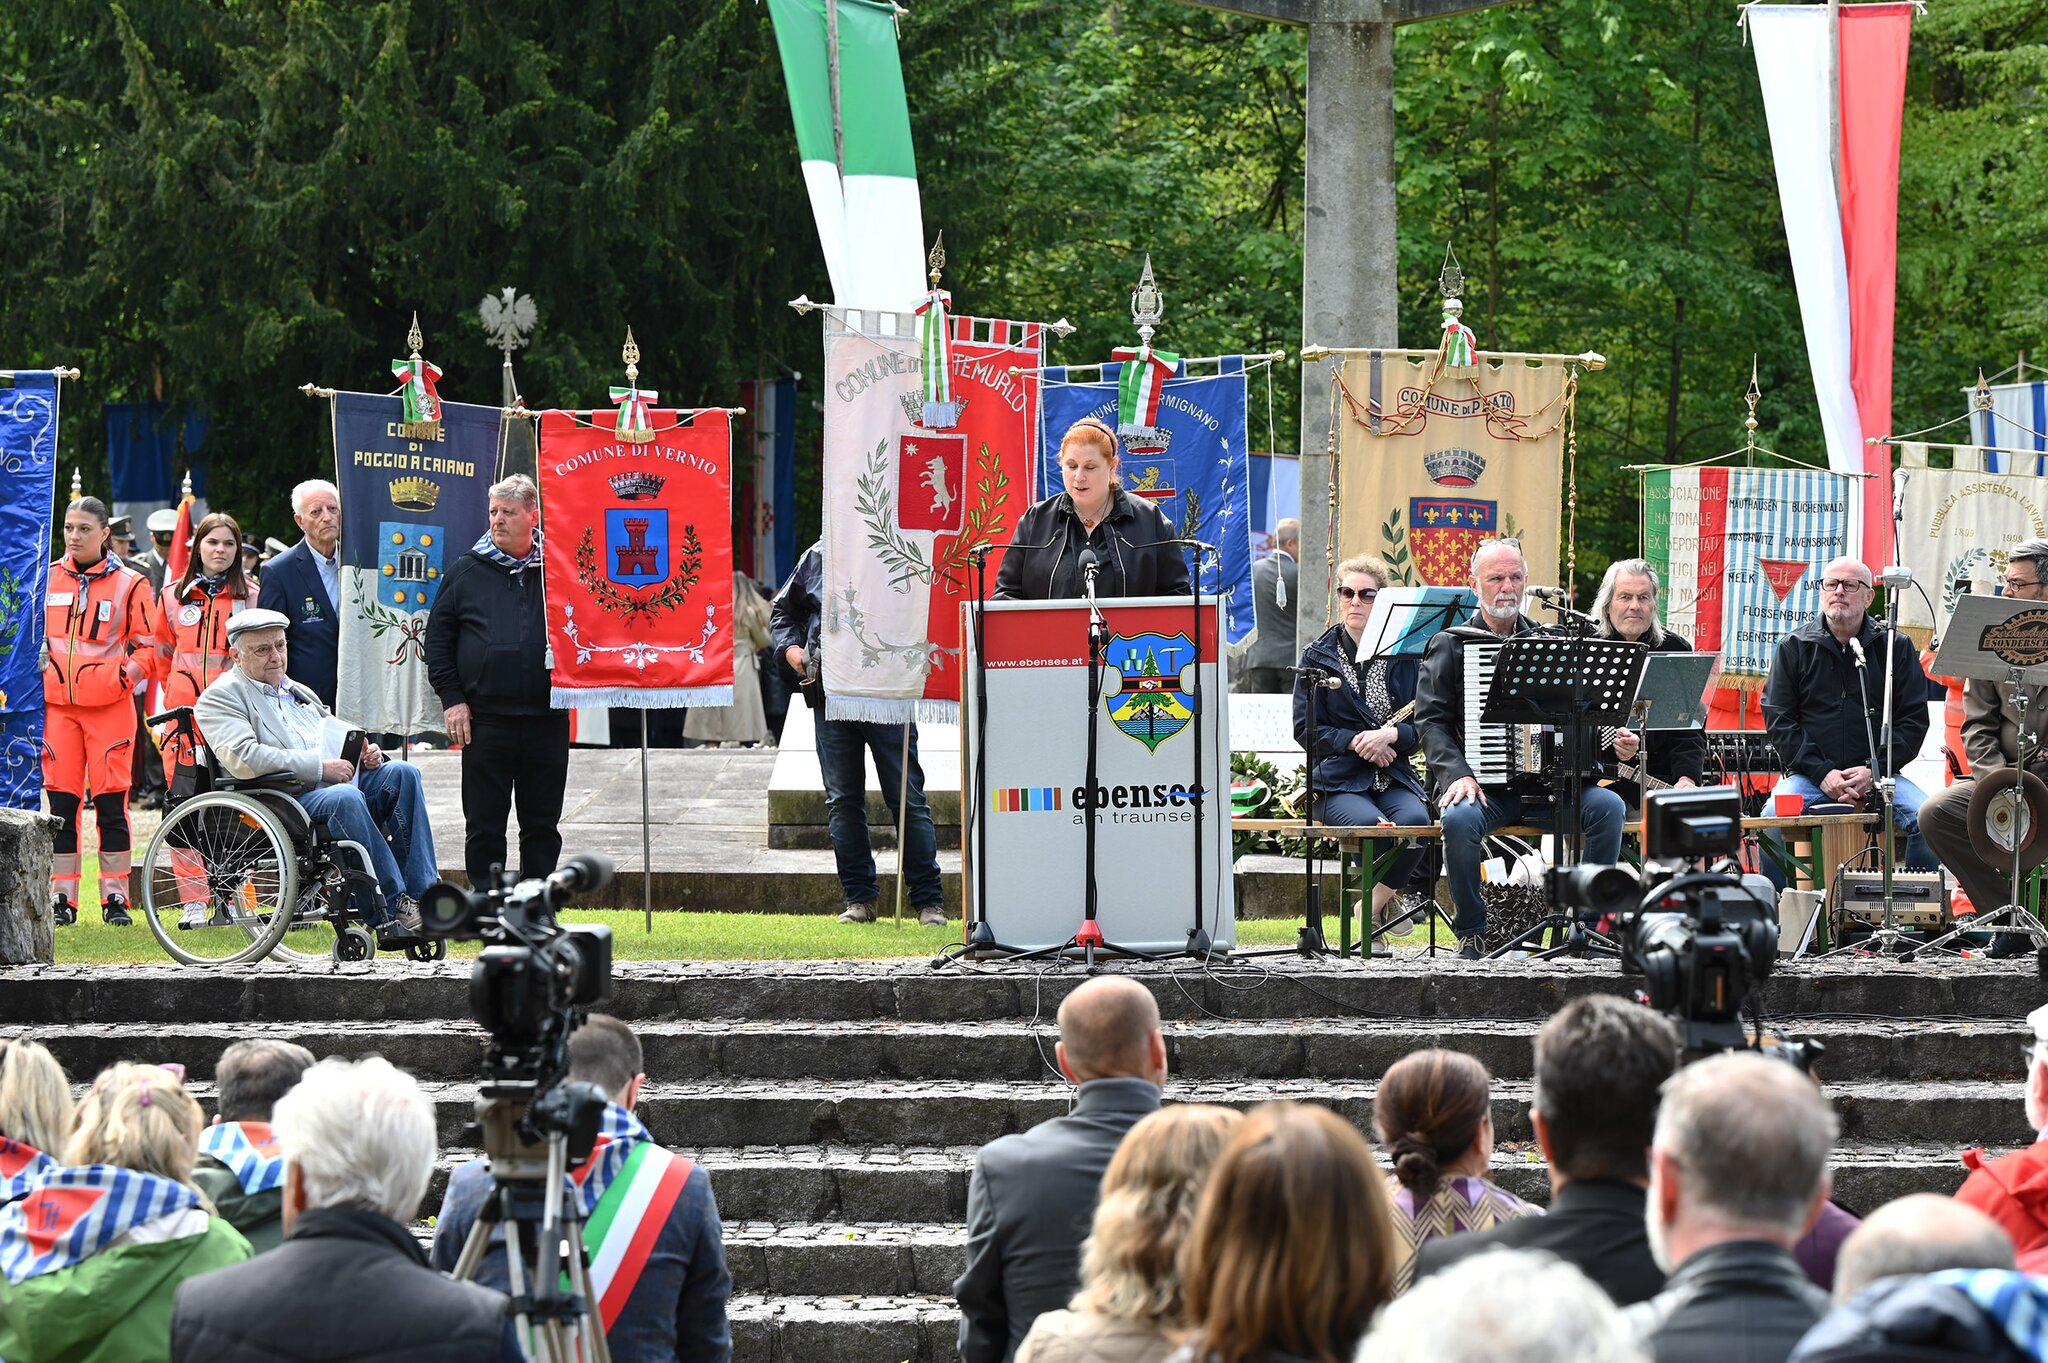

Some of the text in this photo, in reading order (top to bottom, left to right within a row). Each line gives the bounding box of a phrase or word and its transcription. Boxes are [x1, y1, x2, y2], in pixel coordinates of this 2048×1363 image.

[835, 350, 907, 403] COMUNE
[1472, 394, 1513, 414] PATO
[1085, 393, 1220, 432] MUNE RMIGNANO
[387, 422, 446, 443] COE
[408, 442, 424, 453] DI
[354, 451, 476, 478] POGGIO A CAIANO
[554, 444, 718, 477] COMUNE DI VERNIO
[1649, 486, 1722, 501] ASSOCIAZIONE
[1728, 499, 1844, 513] MAUTHAUSEN BUCHENWALD
[1929, 482, 2047, 539] PUBBLICA ASSISTENZA L'AVVENI
[1654, 511, 1713, 527] NAZIONALE
[1648, 533, 1719, 552] EX DEPORTATI
[1727, 532, 1843, 548] AUSCHWITZ RAVENSBRUCK
[1953, 528, 2024, 543] 1899 1999
[1701, 562, 1717, 577] NEI
[1728, 572, 1756, 584] MELK
[1803, 580, 1821, 591] DAC
[1680, 586, 1717, 602] NAZISTI
[1742, 605, 1815, 622] FLOSSENBURG
[1668, 622, 1708, 638] ZIONE
[1736, 631, 1779, 645] EBENSEE
[986, 656, 1084, 668] www.ebensee.at
[1725, 656, 1770, 669] RISIERA DI
